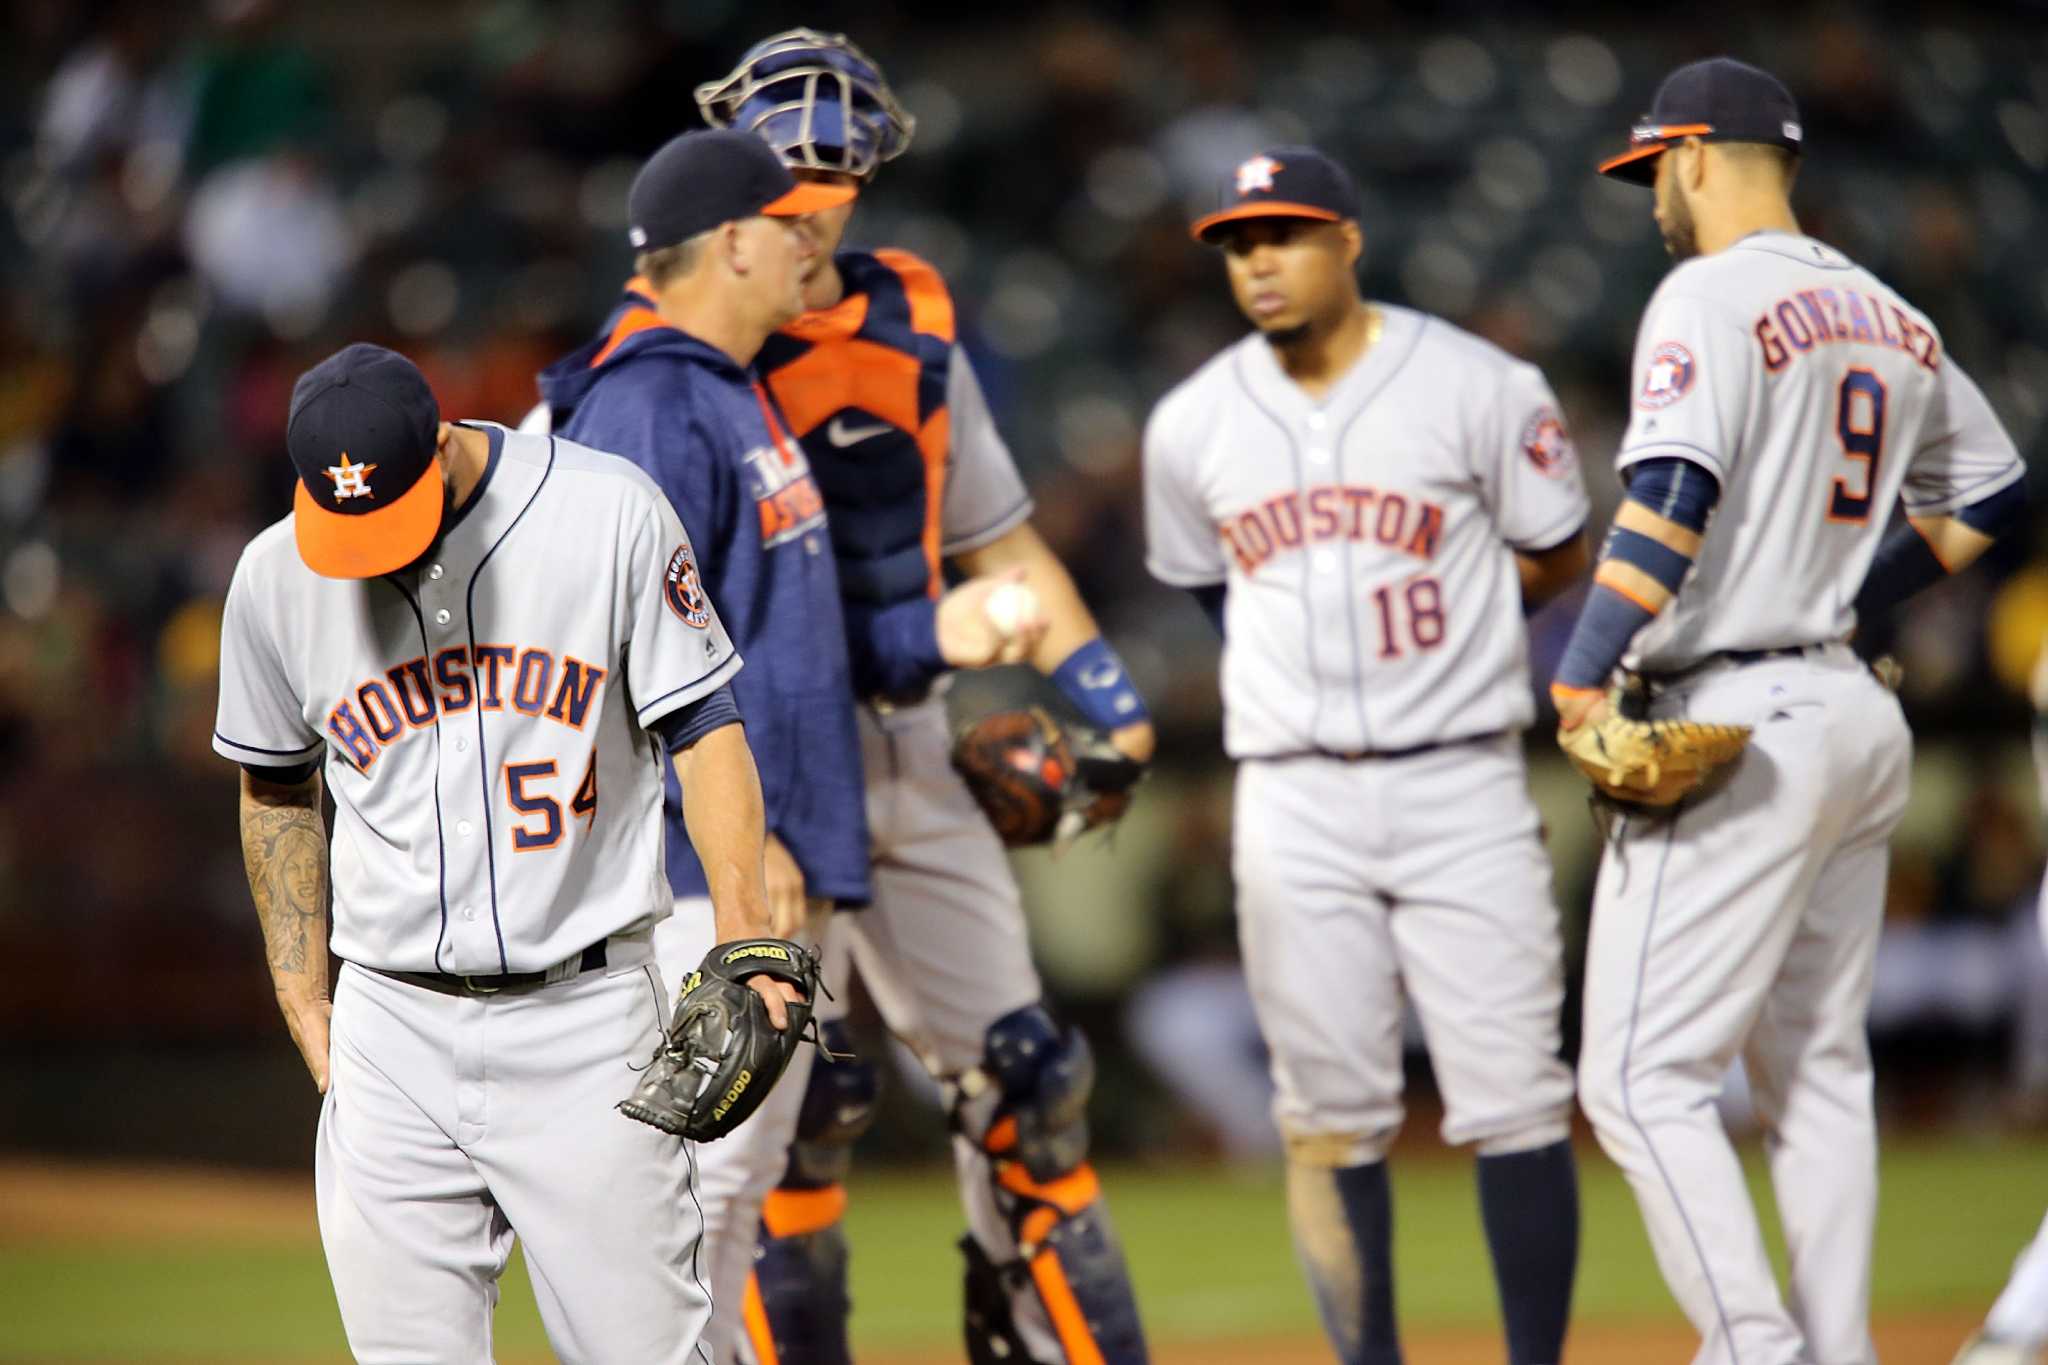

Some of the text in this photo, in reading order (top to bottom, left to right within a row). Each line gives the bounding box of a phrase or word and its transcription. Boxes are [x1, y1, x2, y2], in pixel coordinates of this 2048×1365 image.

[1755, 287, 1940, 373] GONZALEZ
[1824, 363, 1888, 527] 9
[1371, 576, 1447, 660] 18
[326, 644, 608, 775] HOUSTON
[503, 744, 598, 853] 54
